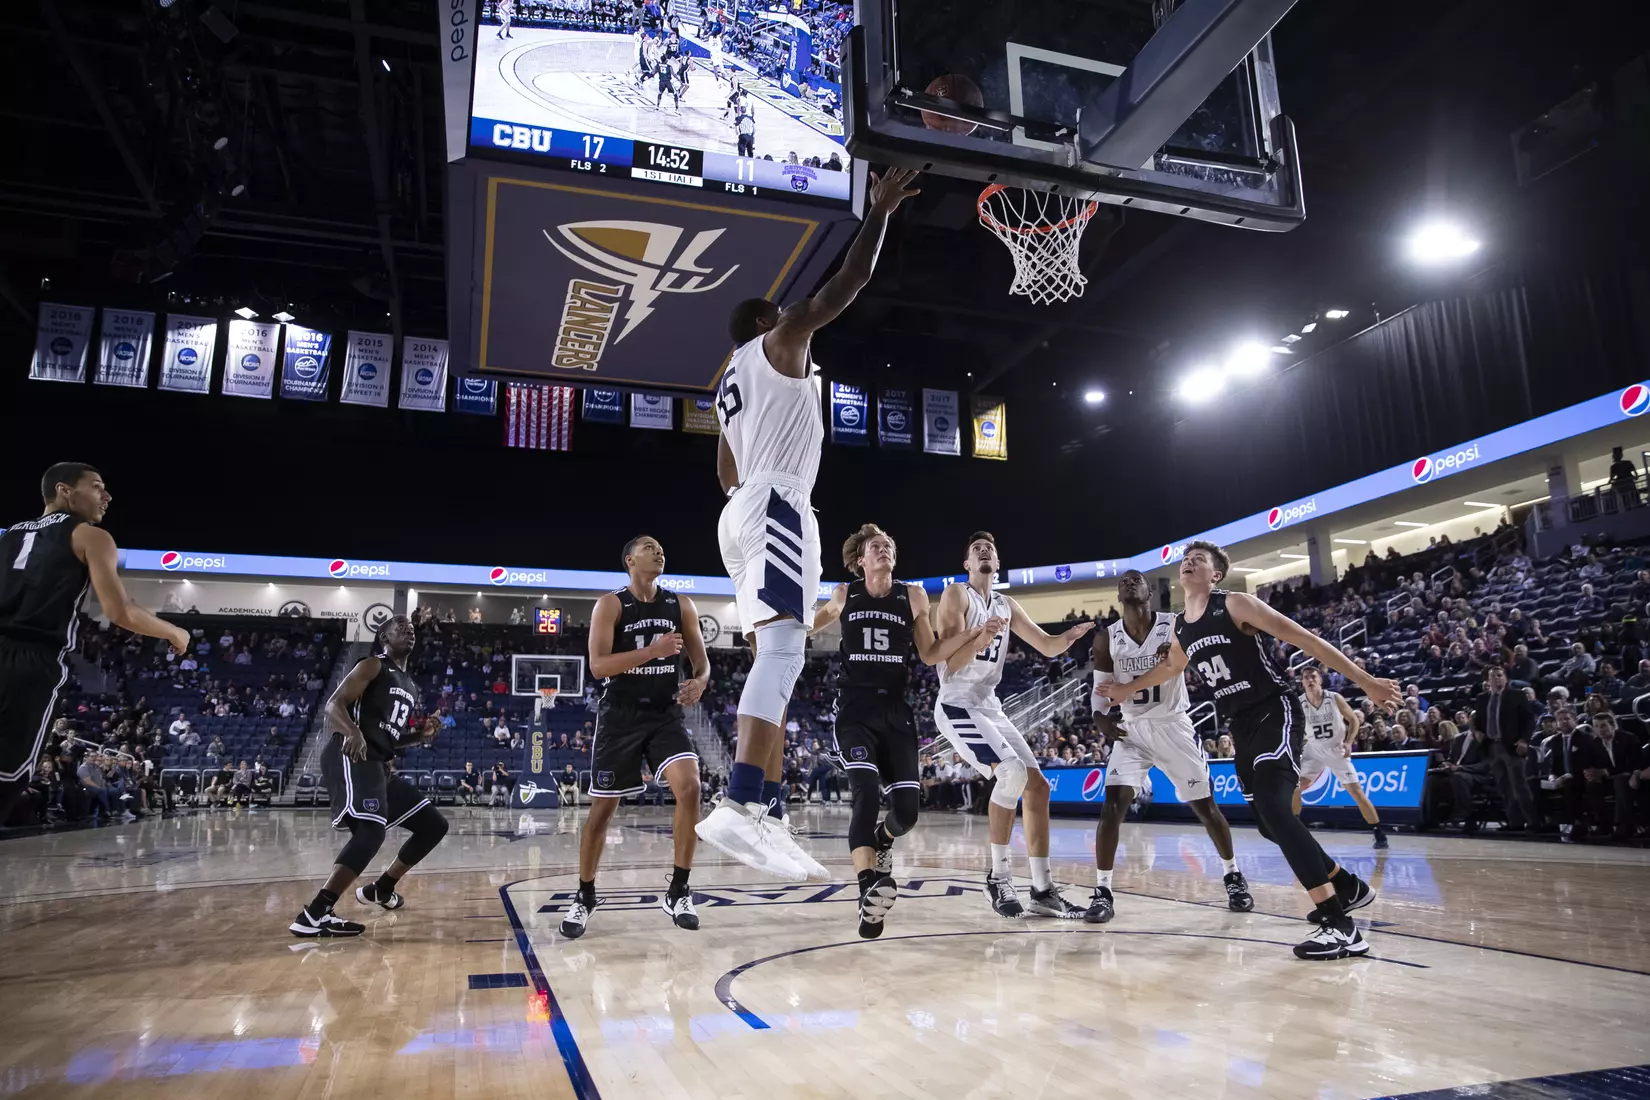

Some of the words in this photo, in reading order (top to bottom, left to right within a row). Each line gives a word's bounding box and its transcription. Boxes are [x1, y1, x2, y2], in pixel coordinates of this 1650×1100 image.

[450, 0, 469, 62] peps
[492, 123, 552, 152] CBU
[582, 135, 605, 159] 17
[648, 145, 690, 171] 14:52
[571, 159, 592, 171] FLS
[599, 163, 607, 173] 2
[735, 159, 756, 182] 11
[644, 170, 663, 180] 1ST
[668, 173, 695, 184] HALF
[725, 181, 746, 193] FLS
[752, 185, 758, 195] 1
[113, 315, 143, 325] 2018
[177, 320, 205, 330] 2017
[551, 278, 626, 371] LANCERS
[241, 328, 268, 338] 016
[300, 332, 324, 342] 016
[231, 344, 275, 353] ASKETBALL
[356, 337, 384, 348] 2015
[412, 343, 439, 353] 2014
[358, 347, 380, 355] MEN'S
[168, 367, 198, 375] DIVISION
[242, 360, 260, 368] NCAA
[225, 378, 271, 388] TOURNAMENT
[233, 373, 261, 381] DIVISION
[348, 381, 377, 390] DIVISION
[838, 384, 860, 393] 2017
[1435, 443, 1480, 475] pepsi
[1284, 498, 1317, 525] pepsi
[13, 531, 38, 569] 1
[183, 555, 226, 570] pepsi
[350, 563, 391, 579] pepsi
[509, 571, 548, 586] pepsi
[1021, 569, 1035, 585] 11
[218, 607, 273, 615] ACADEMICALLY
[320, 610, 359, 618] BIBLICALLY
[539, 609, 561, 619] 14:52
[848, 610, 906, 626] CENTRAL
[538, 618, 557, 633] 26
[624, 618, 677, 634] CENTRAL
[862, 627, 890, 651] 15
[848, 653, 904, 663] ARKANSAS
[1119, 654, 1162, 673] LANCER
[1197, 654, 1232, 688] 34
[1213, 680, 1251, 699] ANSAS
[390, 700, 410, 728] 13
[1312, 723, 1335, 740] 25
[530, 731, 544, 774] CBU
